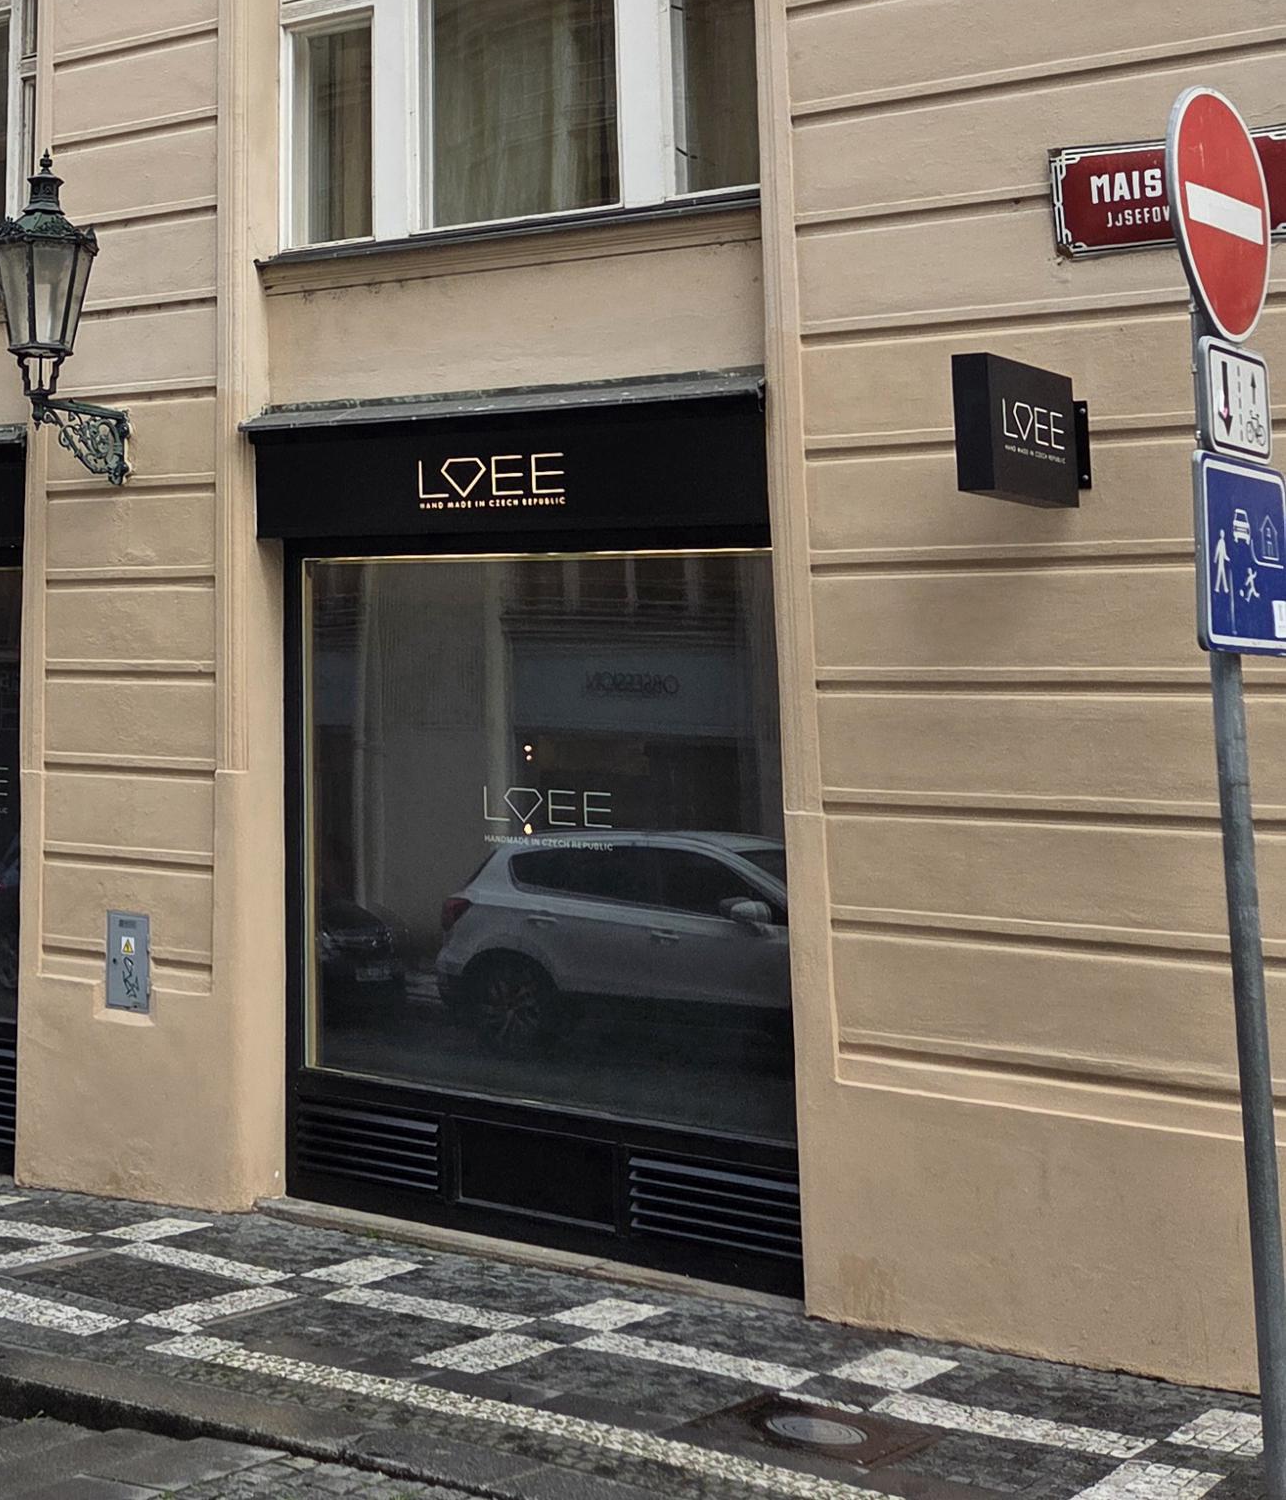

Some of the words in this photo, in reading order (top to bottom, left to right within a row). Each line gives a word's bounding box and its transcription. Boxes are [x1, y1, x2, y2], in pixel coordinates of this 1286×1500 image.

[1090, 168, 1163, 204] MAIS
[419, 501, 444, 509] HAND
[447, 500, 472, 509] MADE
[475, 500, 486, 508] IN
[489, 499, 519, 507] CZECH
[522, 496, 566, 506] REPUBLIC
[484, 835, 529, 845] HANDMADE
[531, 837, 540, 846] IN
[541, 838, 571, 848] CZECH
[571, 840, 613, 851] REPUBLIC
